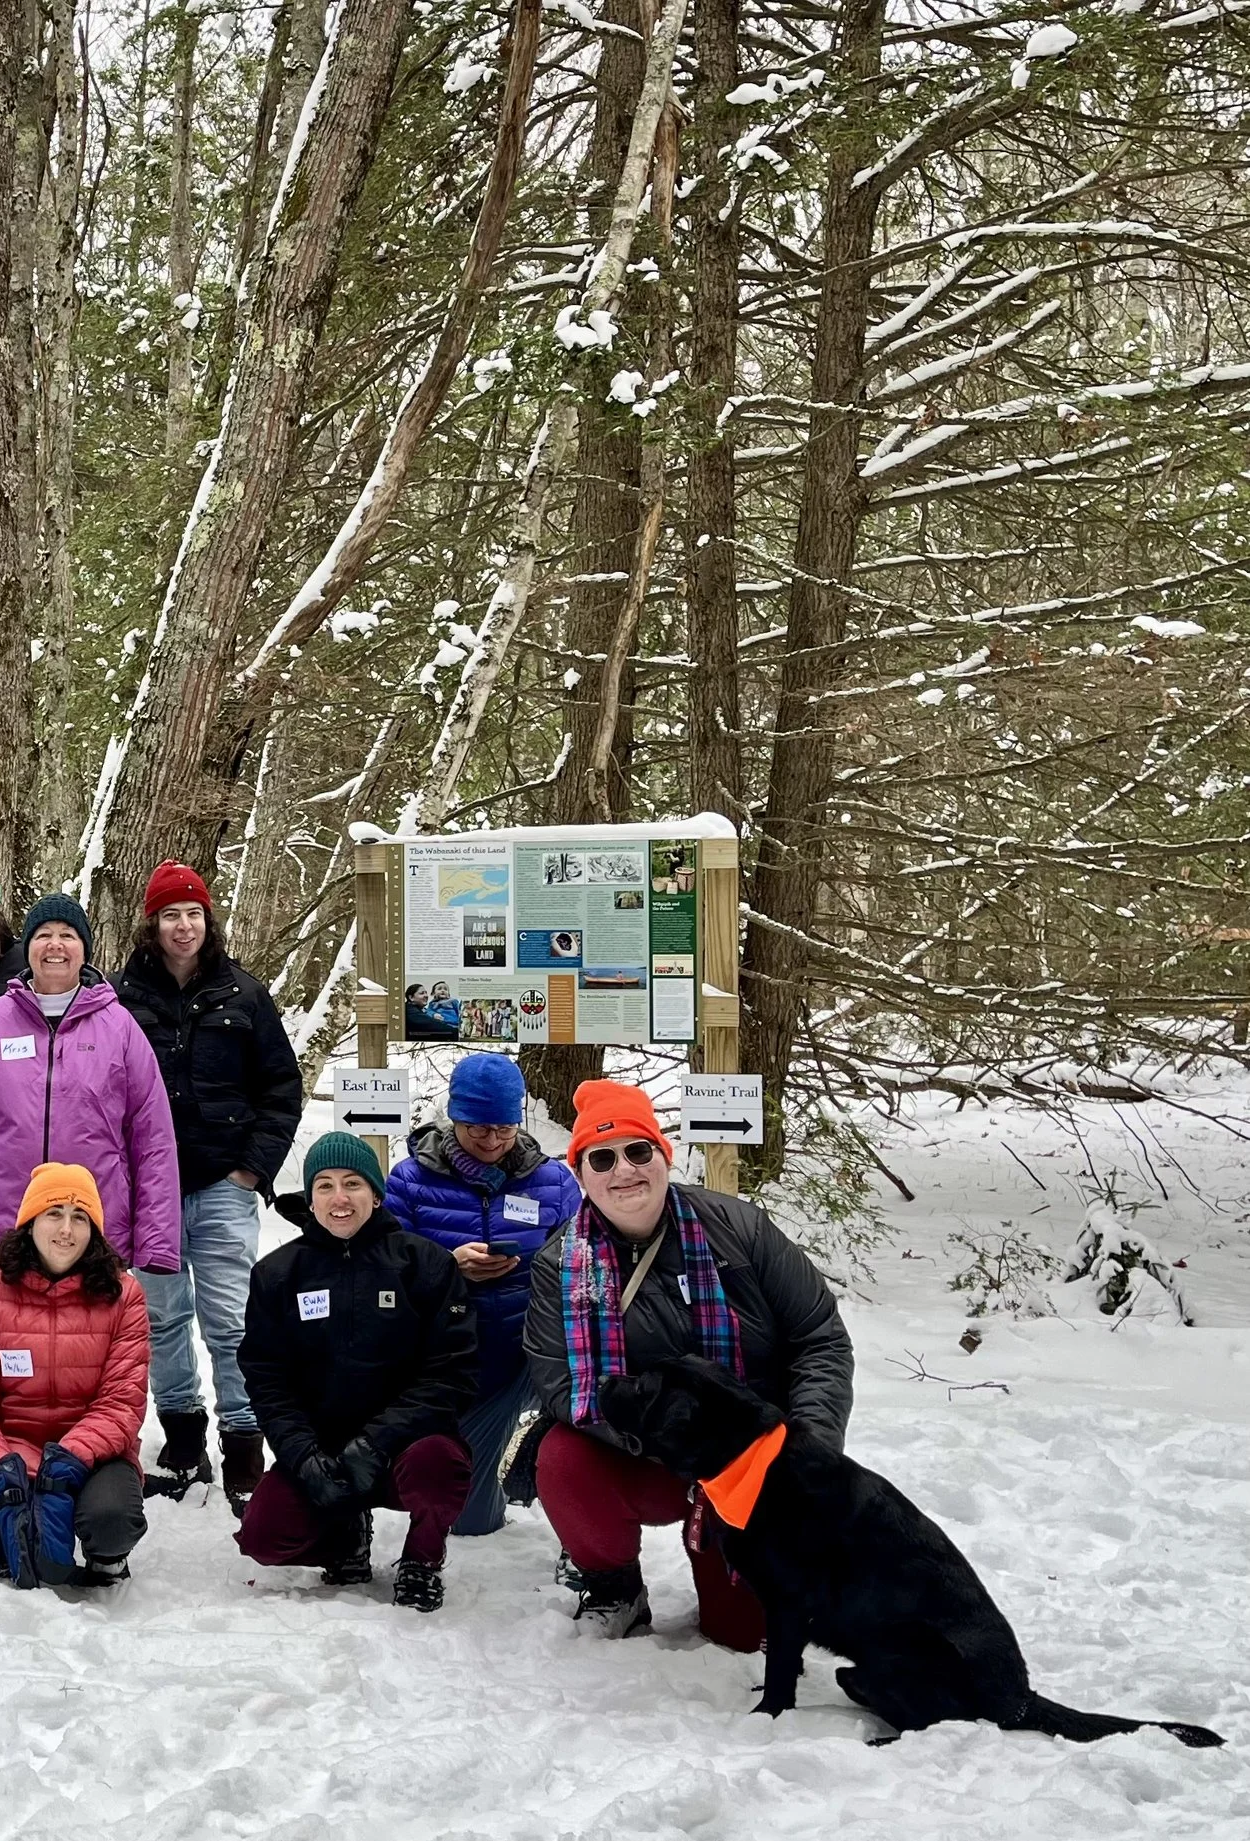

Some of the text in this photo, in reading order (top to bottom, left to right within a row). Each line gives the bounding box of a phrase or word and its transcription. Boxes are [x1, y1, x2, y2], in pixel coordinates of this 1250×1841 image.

[472, 922, 497, 932] ARE ON
[465, 934, 505, 947] INDIGENOUS
[475, 950, 494, 960] LAND
[3, 1043, 28, 1054] Kris
[342, 1079, 401, 1091] East Trail
[684, 1085, 758, 1098] Ravine Trail
[303, 1295, 326, 1306] EWAN
